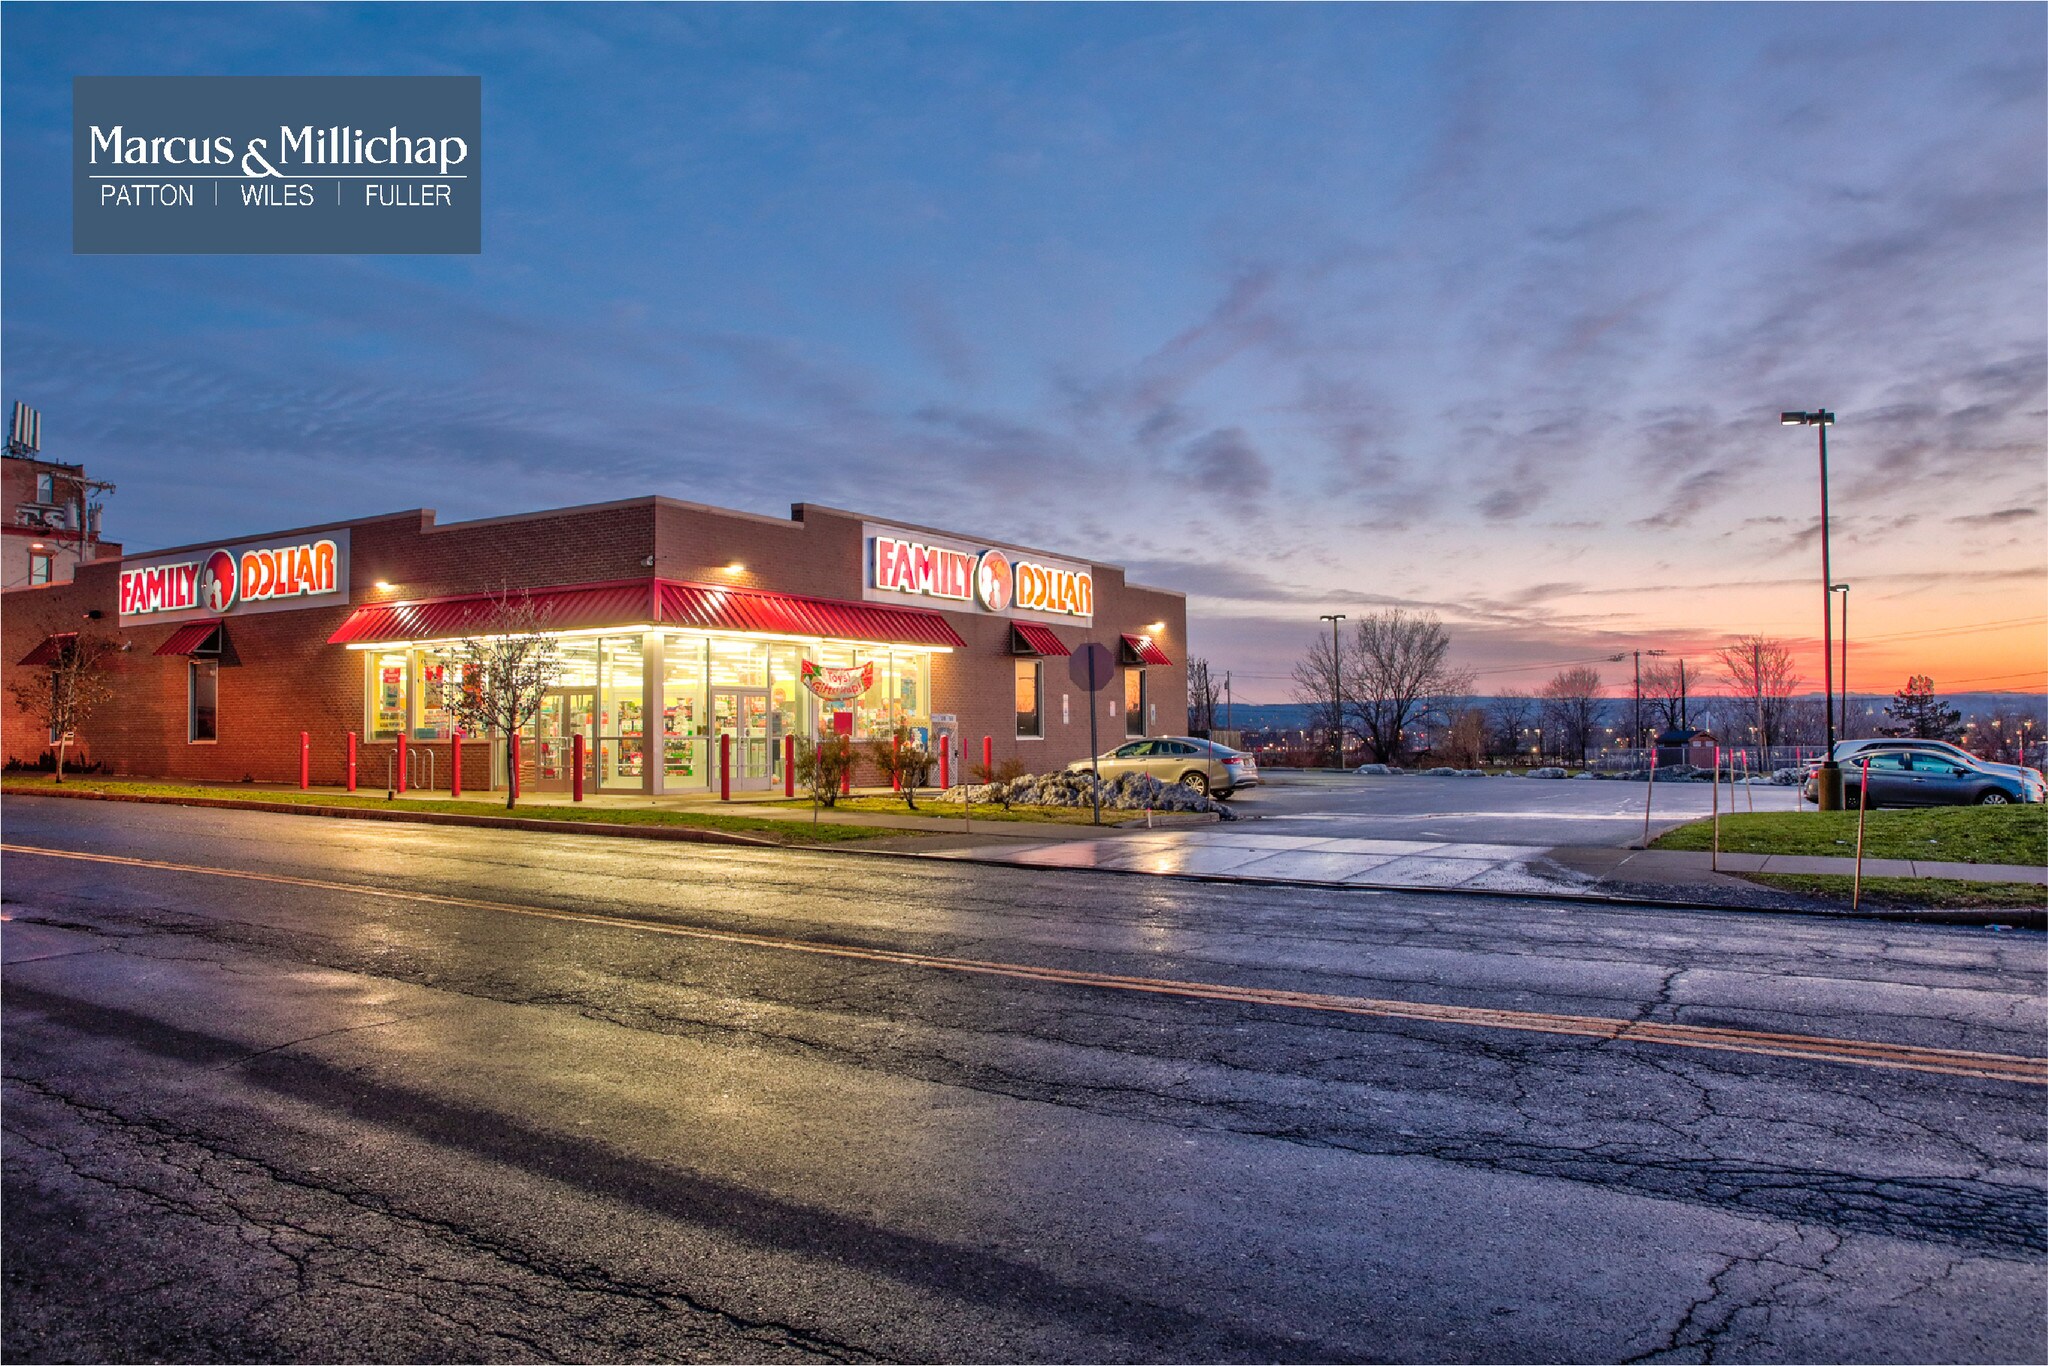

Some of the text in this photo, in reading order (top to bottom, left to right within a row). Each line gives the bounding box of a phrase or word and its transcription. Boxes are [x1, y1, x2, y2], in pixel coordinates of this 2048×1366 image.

[120, 540, 337, 615] FAMILY DOLLAR
[876, 537, 1093, 617] FAMILY DOLLAR
